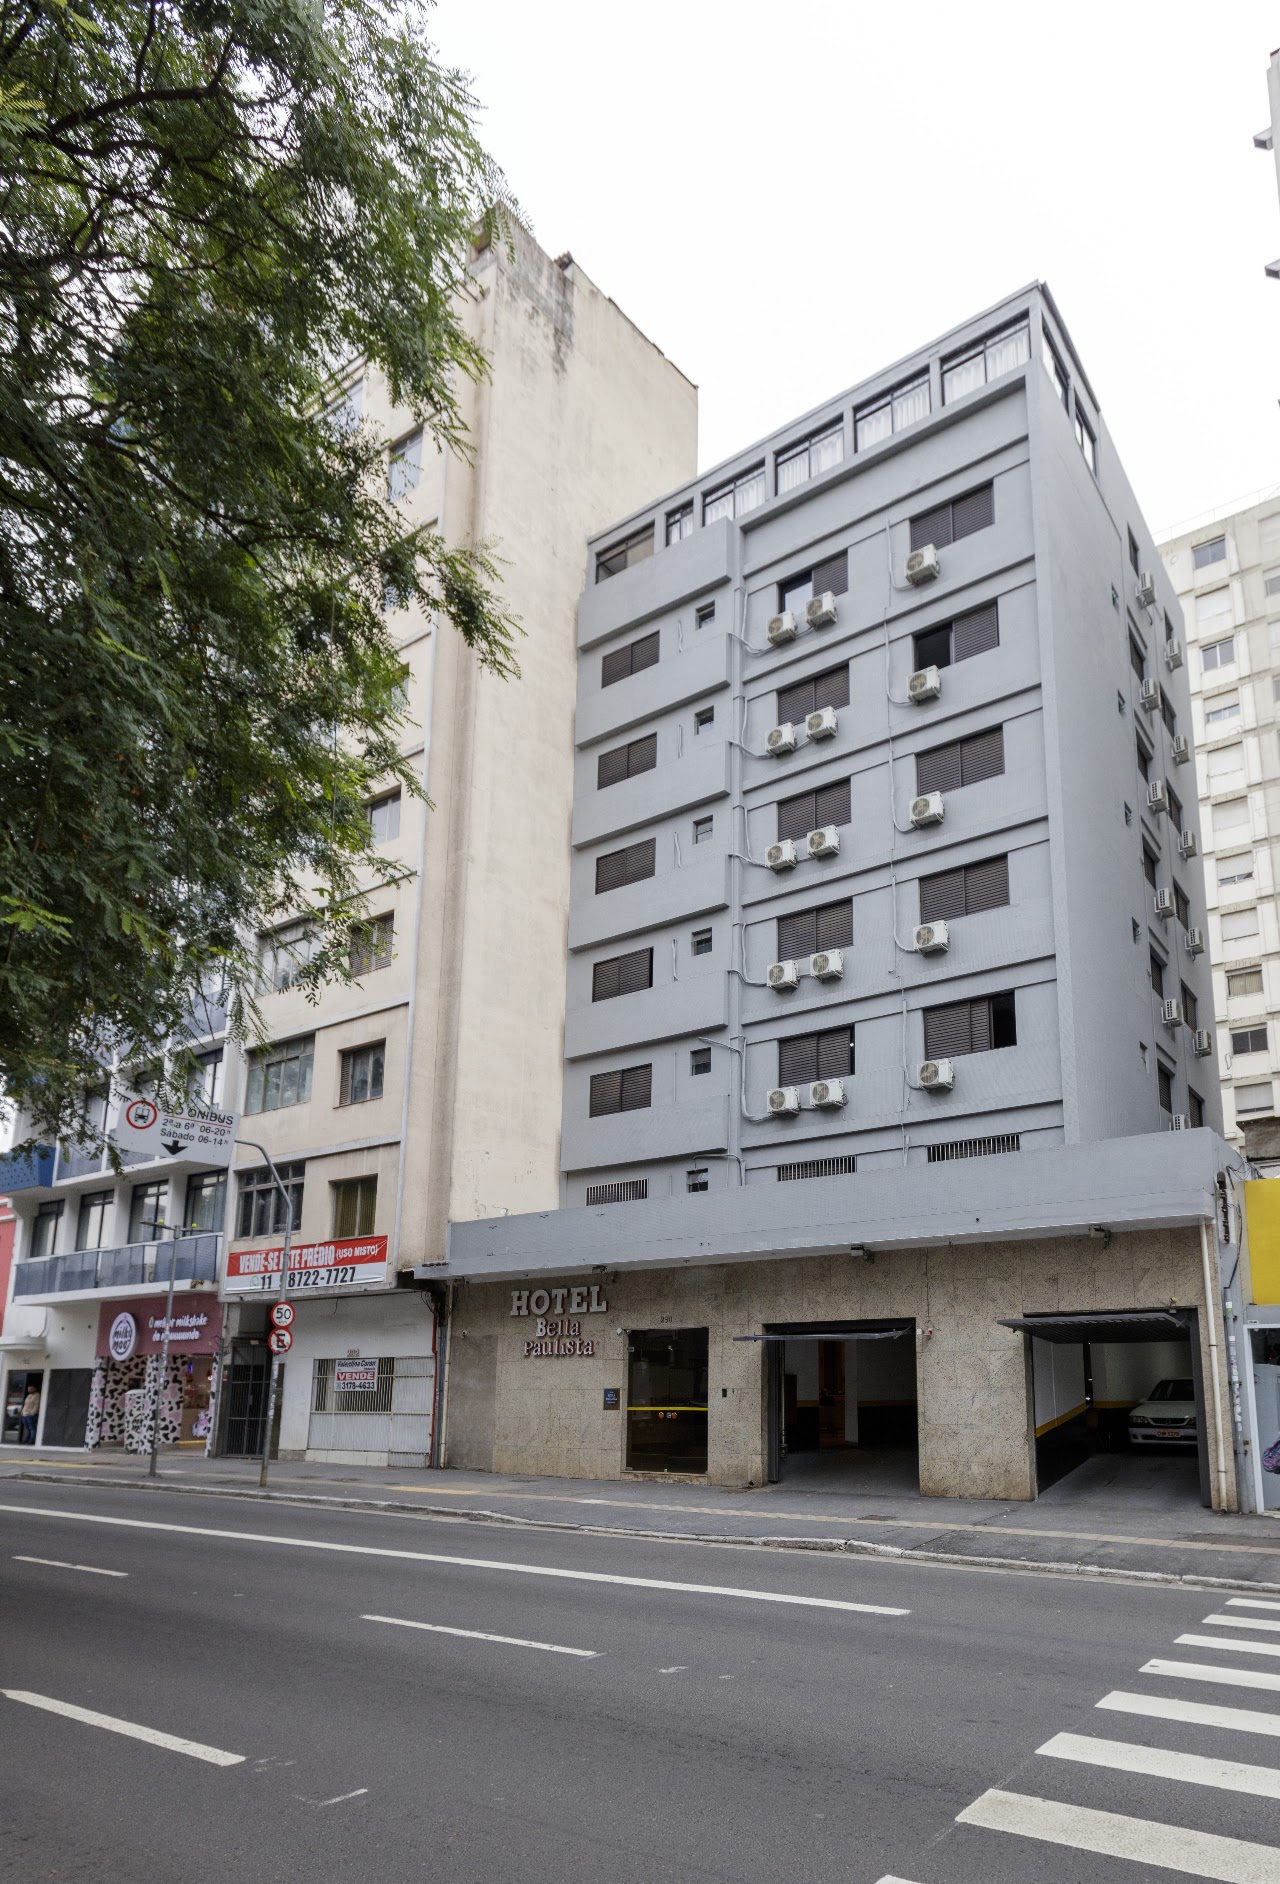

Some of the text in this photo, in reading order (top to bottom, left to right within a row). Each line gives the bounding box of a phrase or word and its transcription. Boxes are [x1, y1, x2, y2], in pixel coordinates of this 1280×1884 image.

[160, 1127, 195, 1141] Sábado
[239, 1243, 378, 1274] VENDE-SE ETE PRÉDIO (USO MISTO)
[260, 1266, 356, 1290] 11 8722-7727
[510, 1285, 608, 1316] HOTEL
[275, 1307, 292, 1320] 50
[536, 1317, 580, 1337] Bella
[524, 1338, 594, 1356] Paulista
[338, 1371, 374, 1380] VENDE
[341, 1381, 375, 1390] 3178-4633
